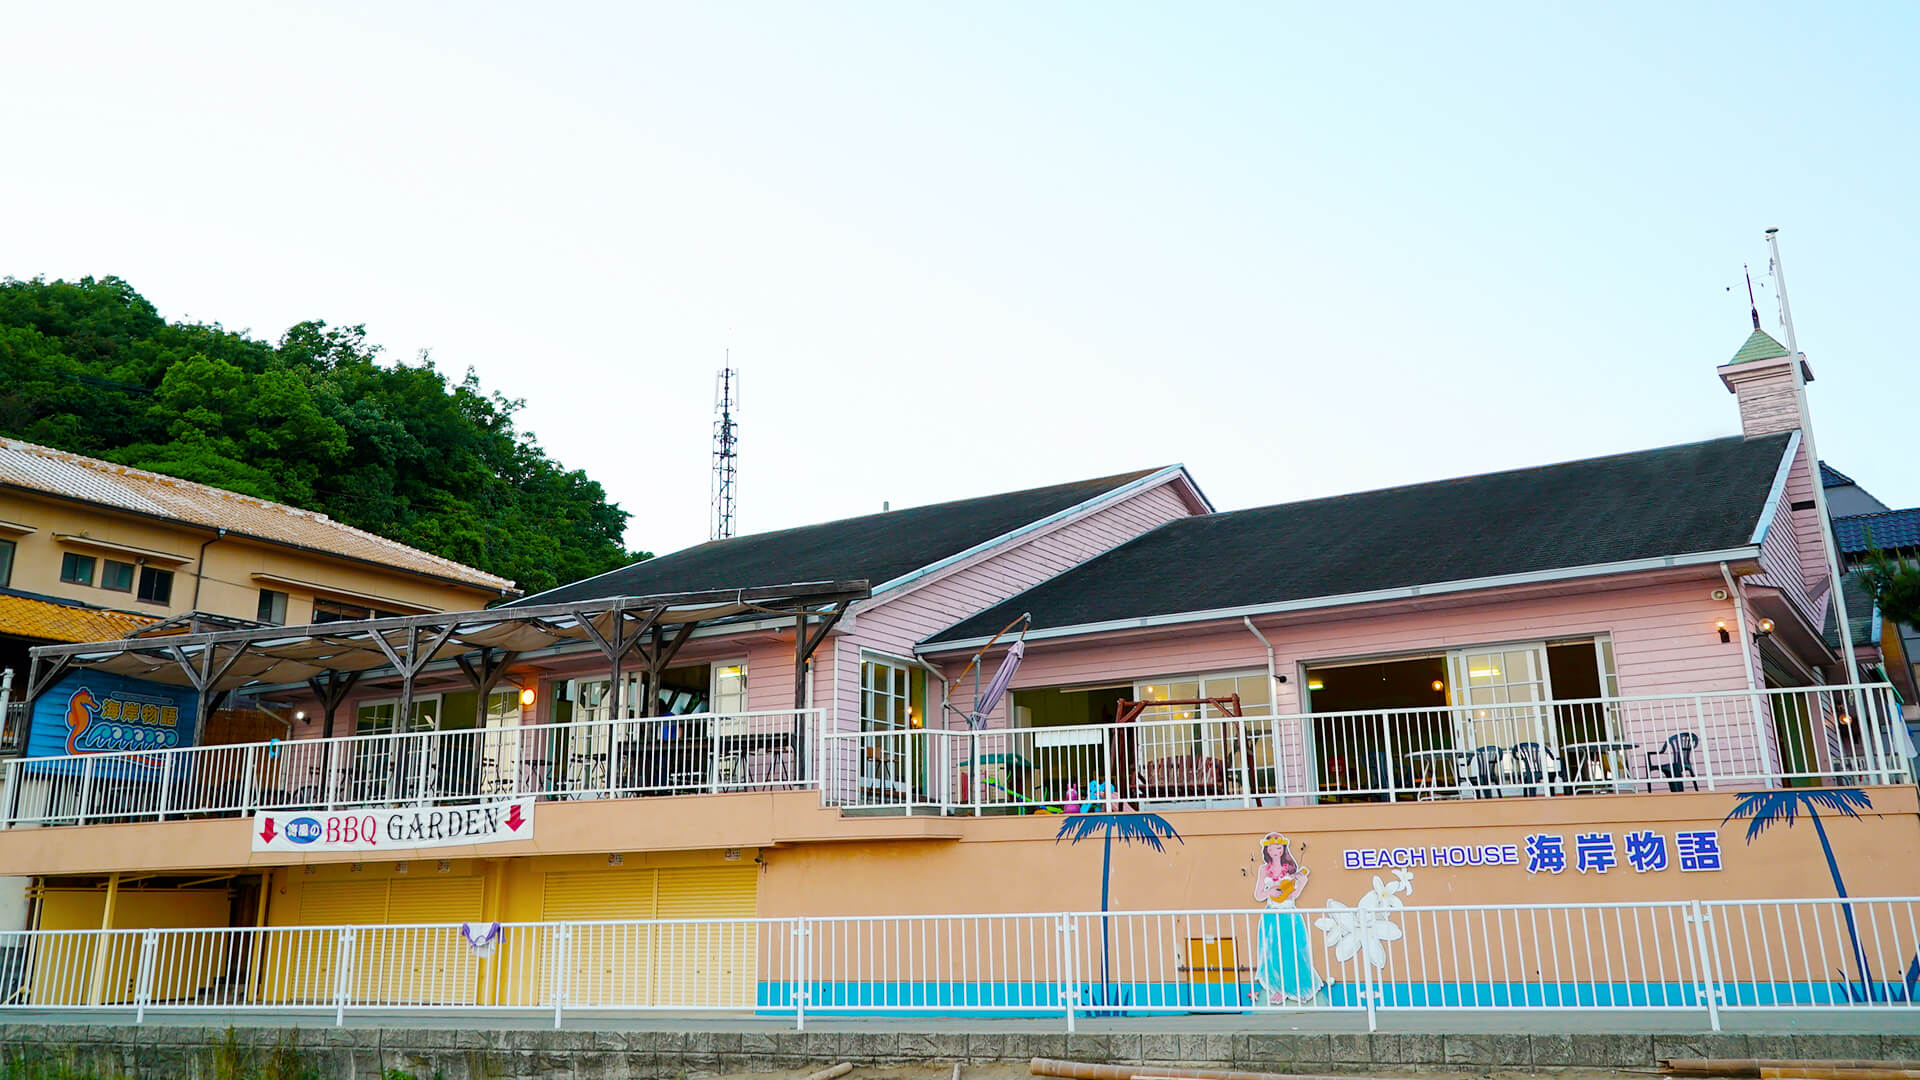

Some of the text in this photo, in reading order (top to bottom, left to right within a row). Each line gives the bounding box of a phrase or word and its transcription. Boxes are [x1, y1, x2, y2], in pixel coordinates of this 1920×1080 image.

[101, 699, 178, 726] 海岸物語
[326, 816, 377, 845] BBQ
[387, 807, 499, 841] GARDEN
[1344, 831, 1722, 873] BEACH HOUSE 海岸物語
